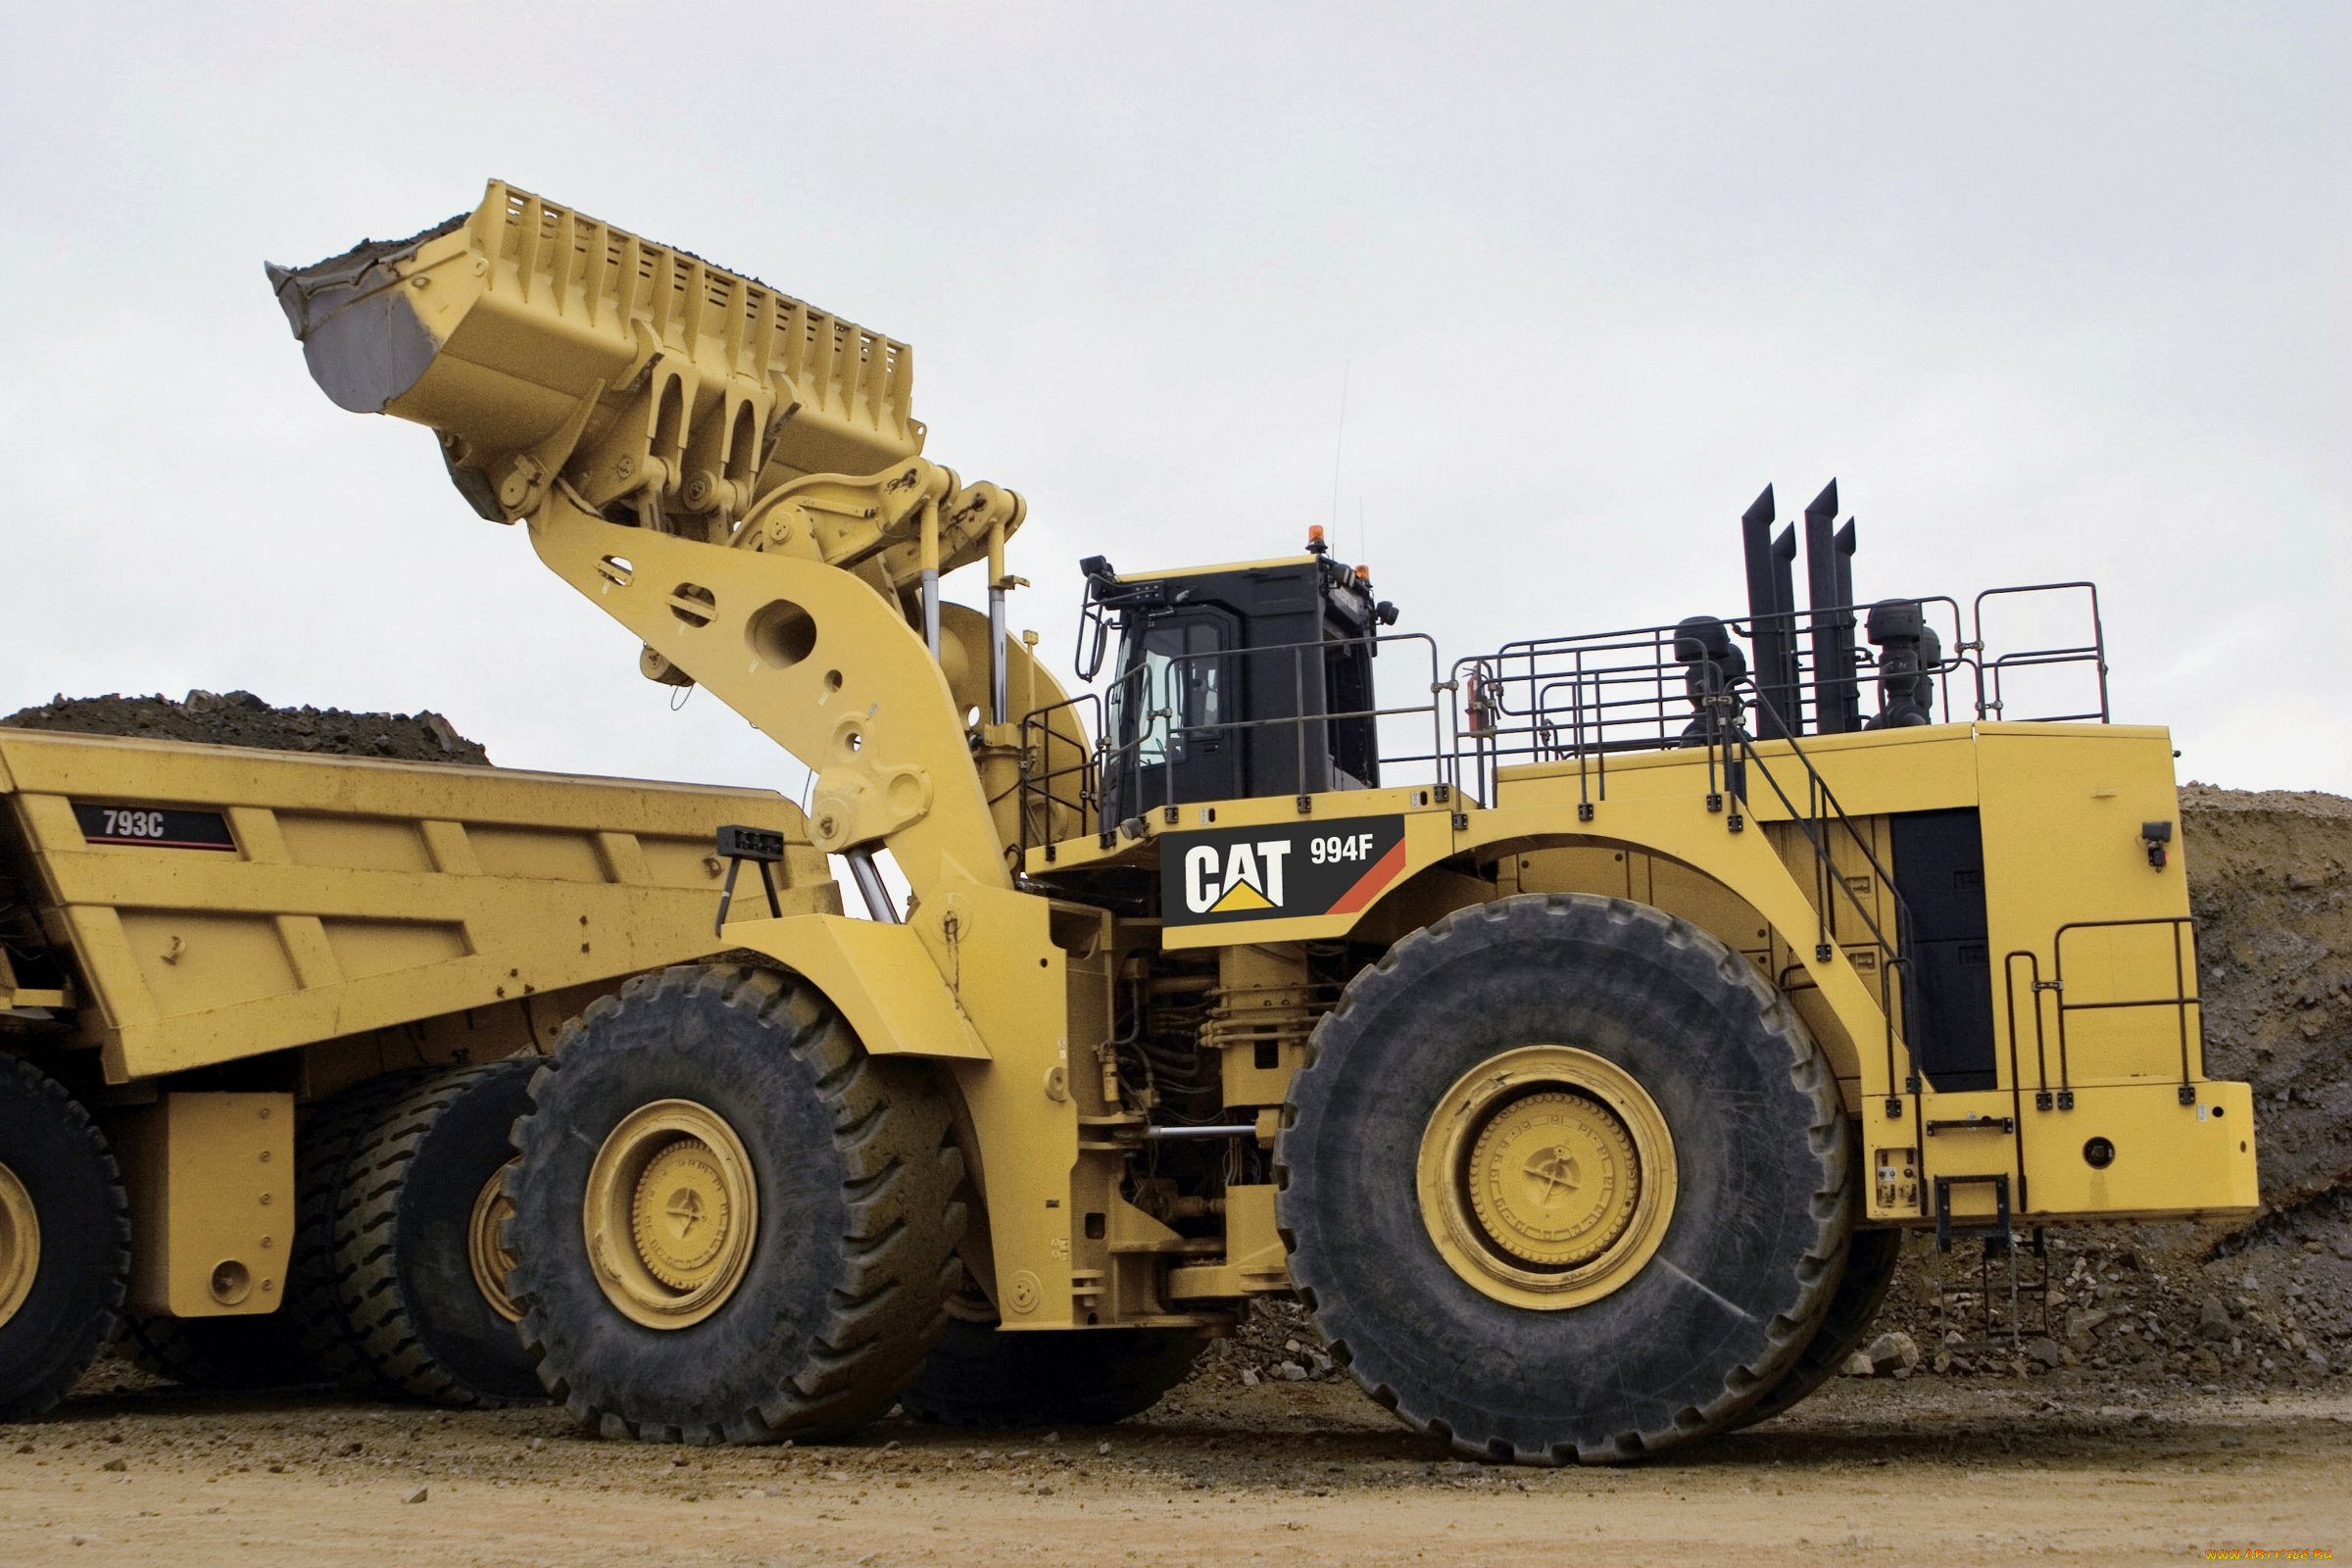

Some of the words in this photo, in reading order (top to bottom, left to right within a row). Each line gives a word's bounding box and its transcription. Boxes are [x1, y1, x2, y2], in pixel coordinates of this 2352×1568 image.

[103, 809, 164, 837] 793C
[1310, 834, 1373, 864] 994F
[1185, 839, 1292, 913] CAT
